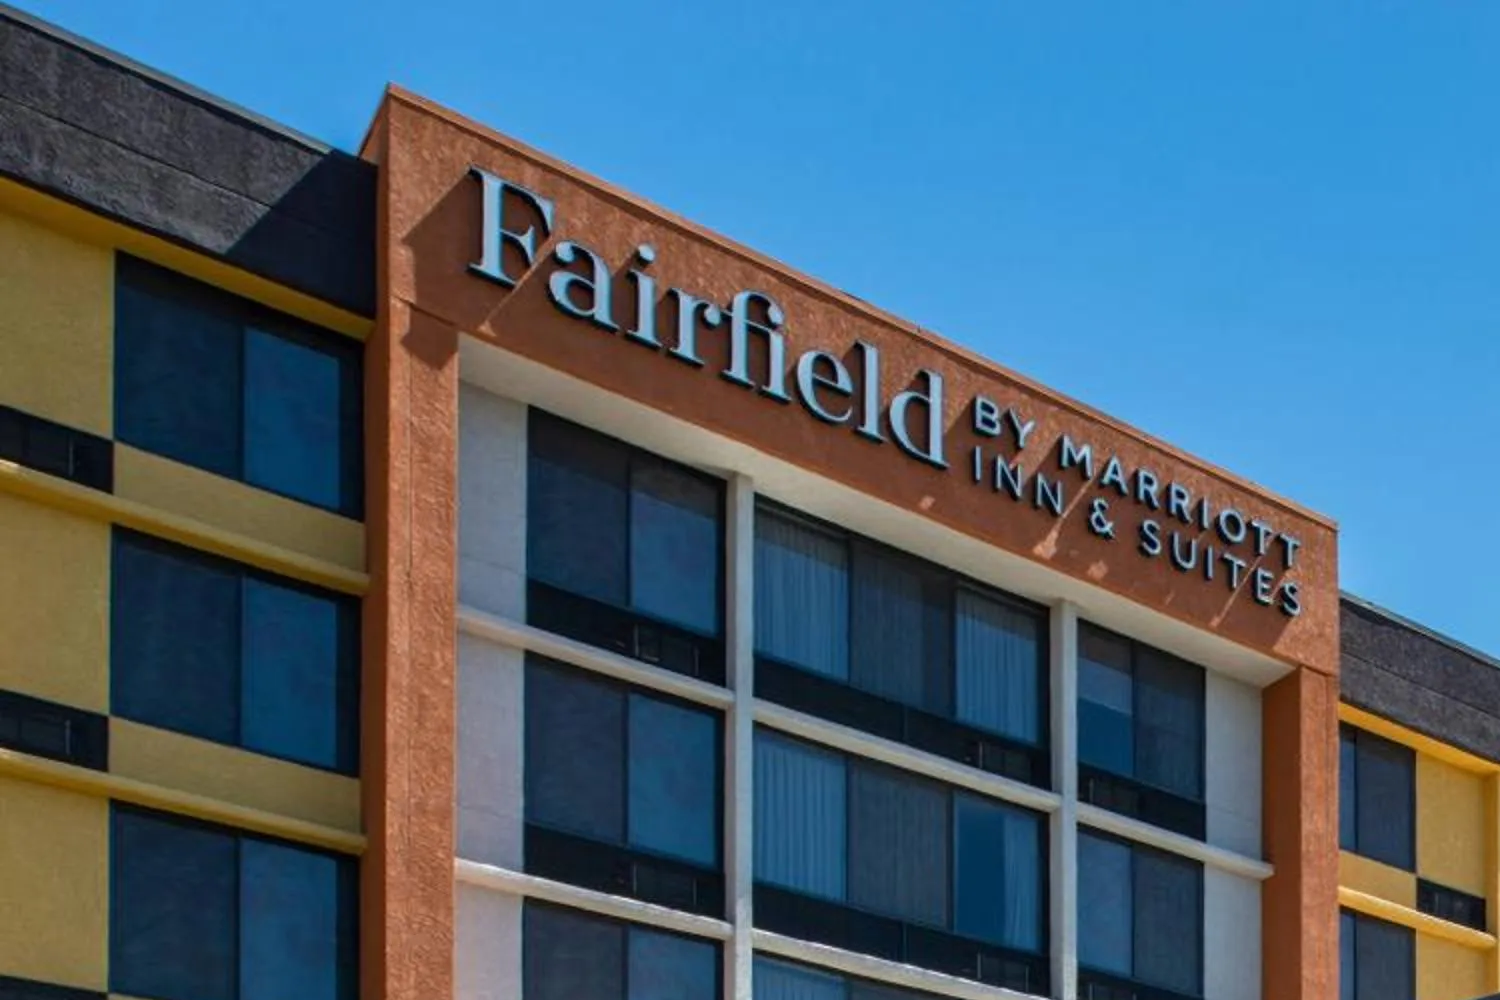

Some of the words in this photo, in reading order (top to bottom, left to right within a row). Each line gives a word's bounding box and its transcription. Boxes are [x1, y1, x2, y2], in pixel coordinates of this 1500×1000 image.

[466, 164, 951, 470] Fairfield
[973, 396, 1035, 449] BY
[1058, 433, 1301, 568] MARRIOTT
[974, 445, 1064, 516] INN
[1088, 496, 1115, 541] &
[1138, 518, 1301, 618] SUITES
